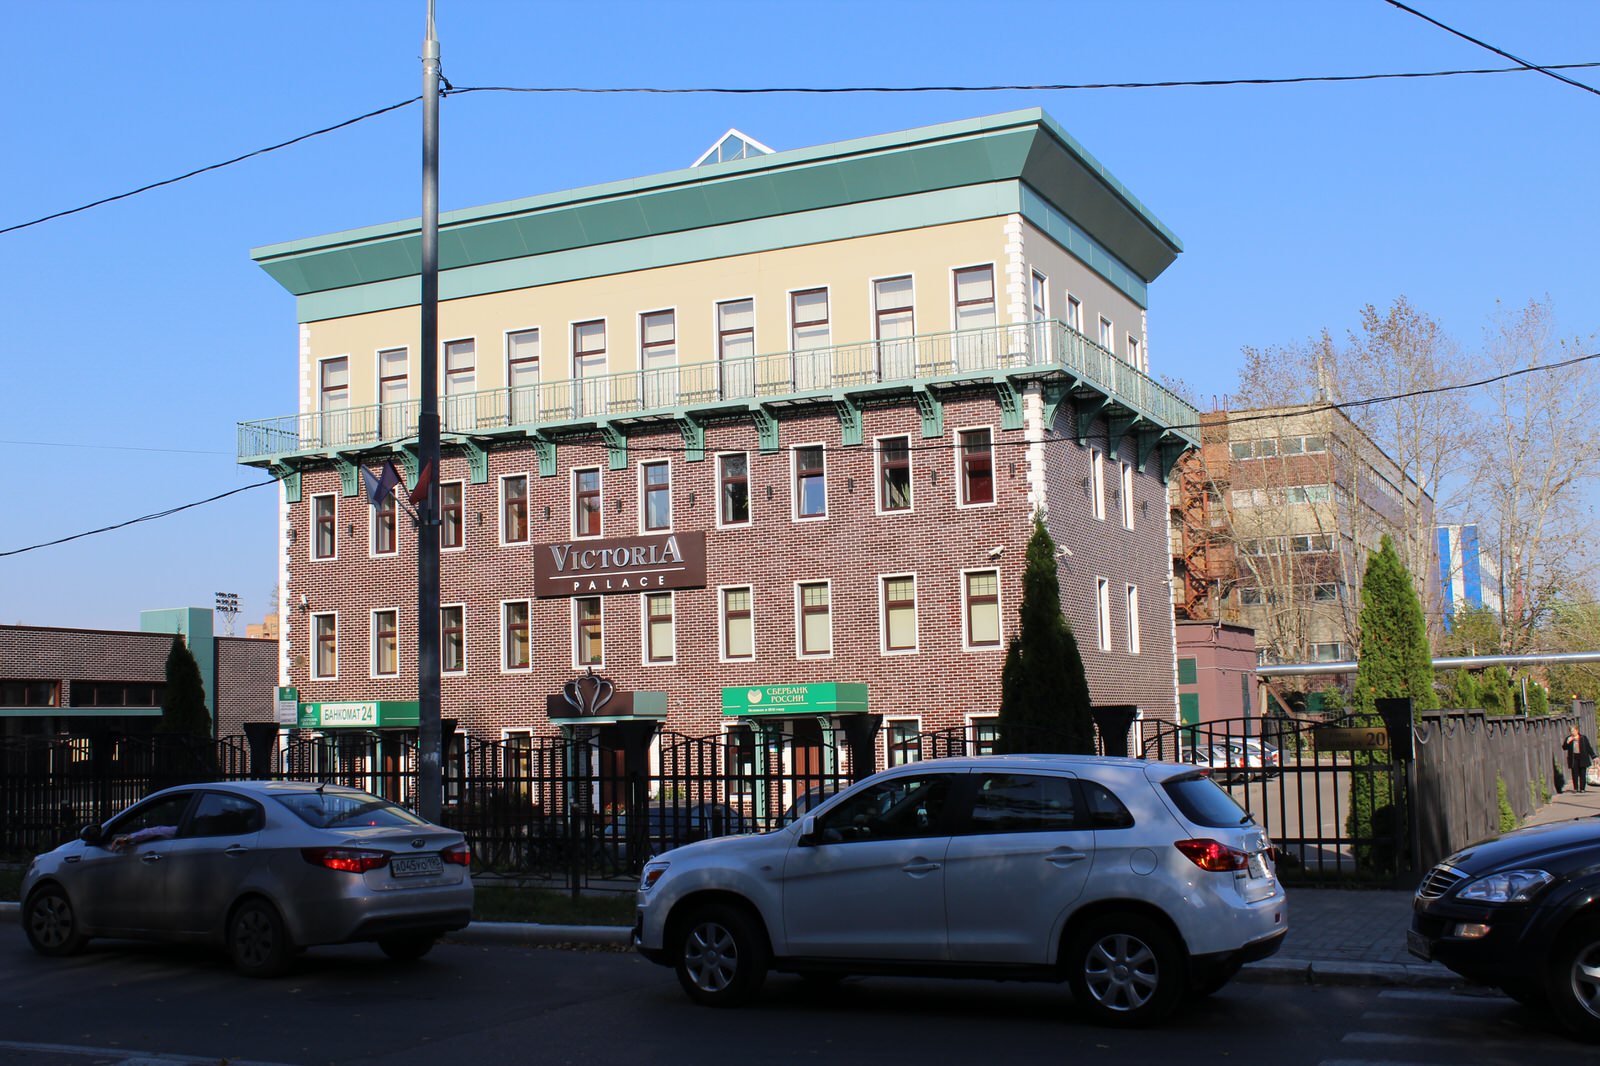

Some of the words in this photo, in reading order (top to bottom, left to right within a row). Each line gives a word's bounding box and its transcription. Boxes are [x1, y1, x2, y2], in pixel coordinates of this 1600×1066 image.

[549, 535, 685, 572] VICTORIA
[573, 575, 665, 592] PALACE
[766, 686, 809, 696] СБЕРБАНК
[771, 694, 805, 703] РОССИИ
[324, 708, 361, 721] БАНКОМАТ
[361, 706, 372, 721] 24
[1366, 732, 1386, 746] 20
